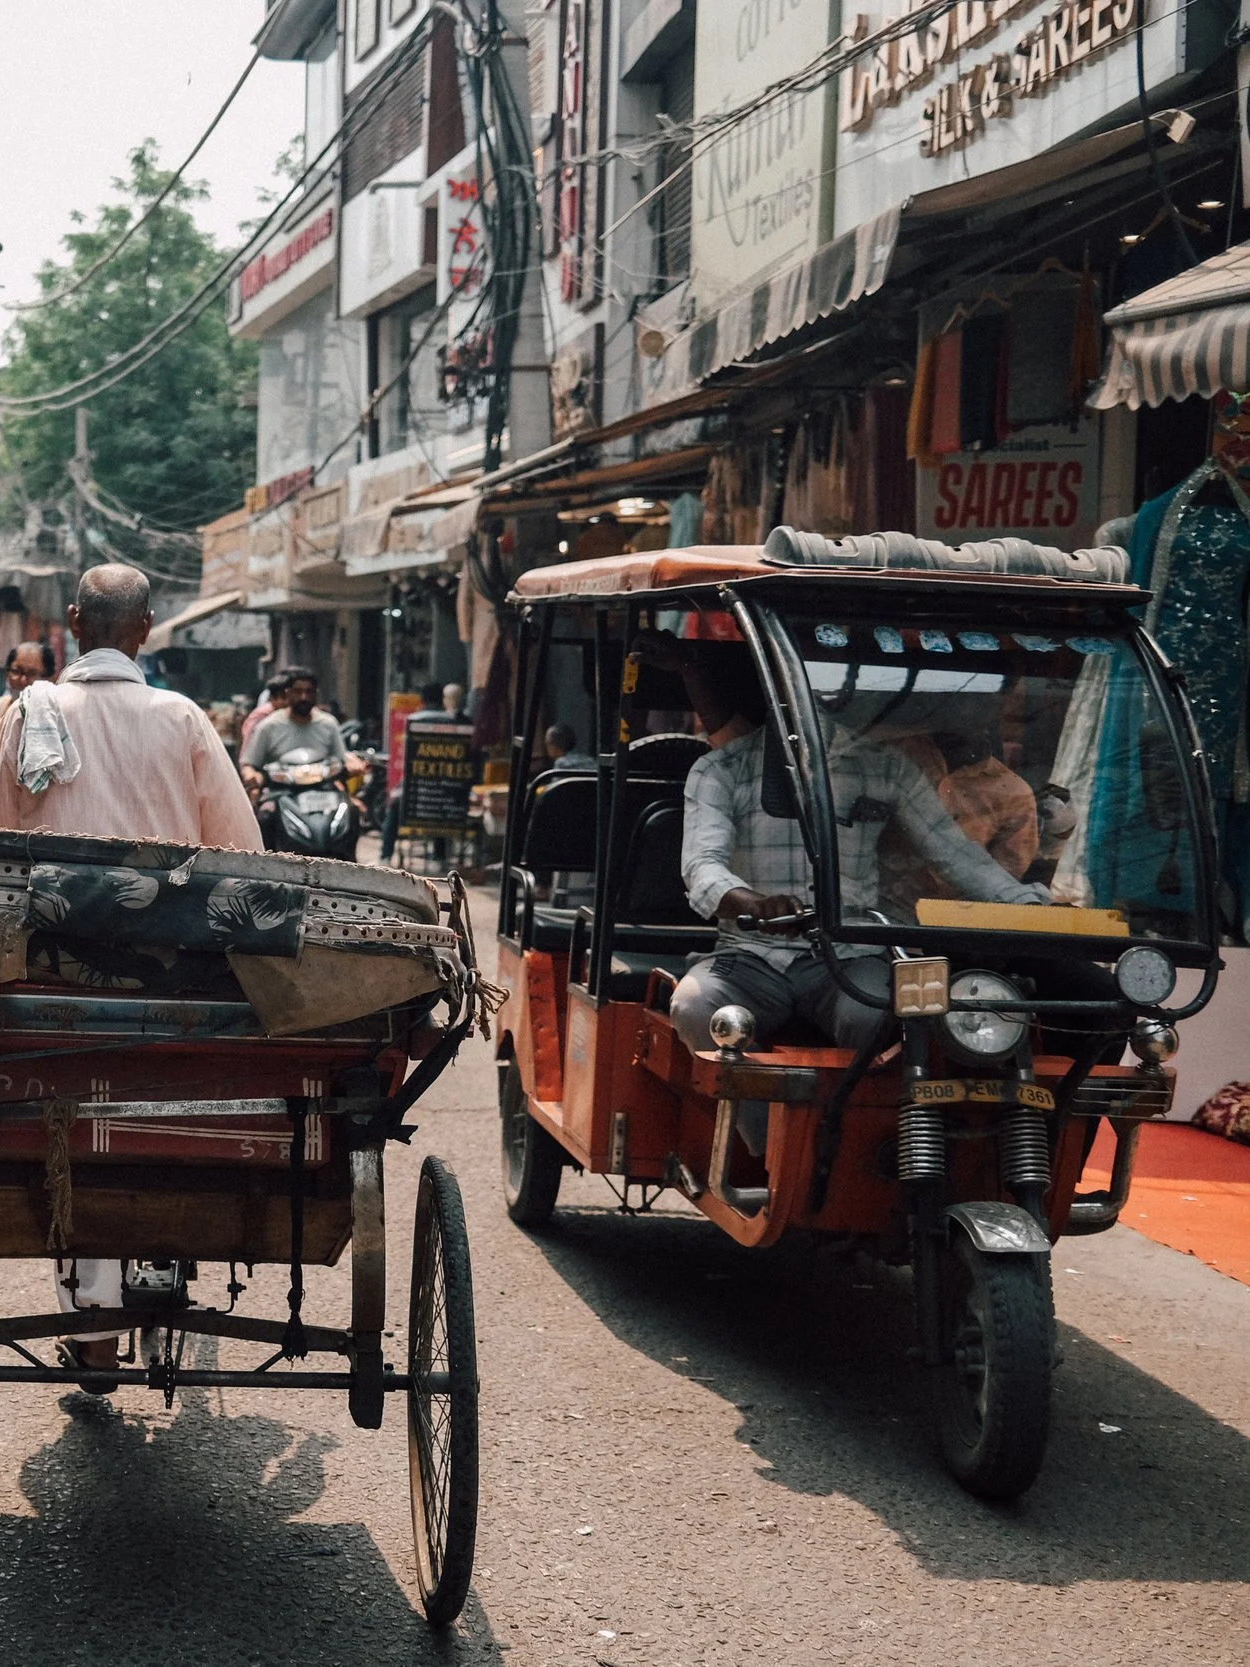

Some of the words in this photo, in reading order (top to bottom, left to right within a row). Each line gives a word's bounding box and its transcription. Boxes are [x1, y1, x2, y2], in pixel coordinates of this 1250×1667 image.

[918, 74, 979, 154] SILK
[934, 461, 1083, 529] SAREES
[417, 743, 466, 759] ANAND
[411, 760, 475, 778] TEXTILES
[912, 1084, 954, 1099] PB08
